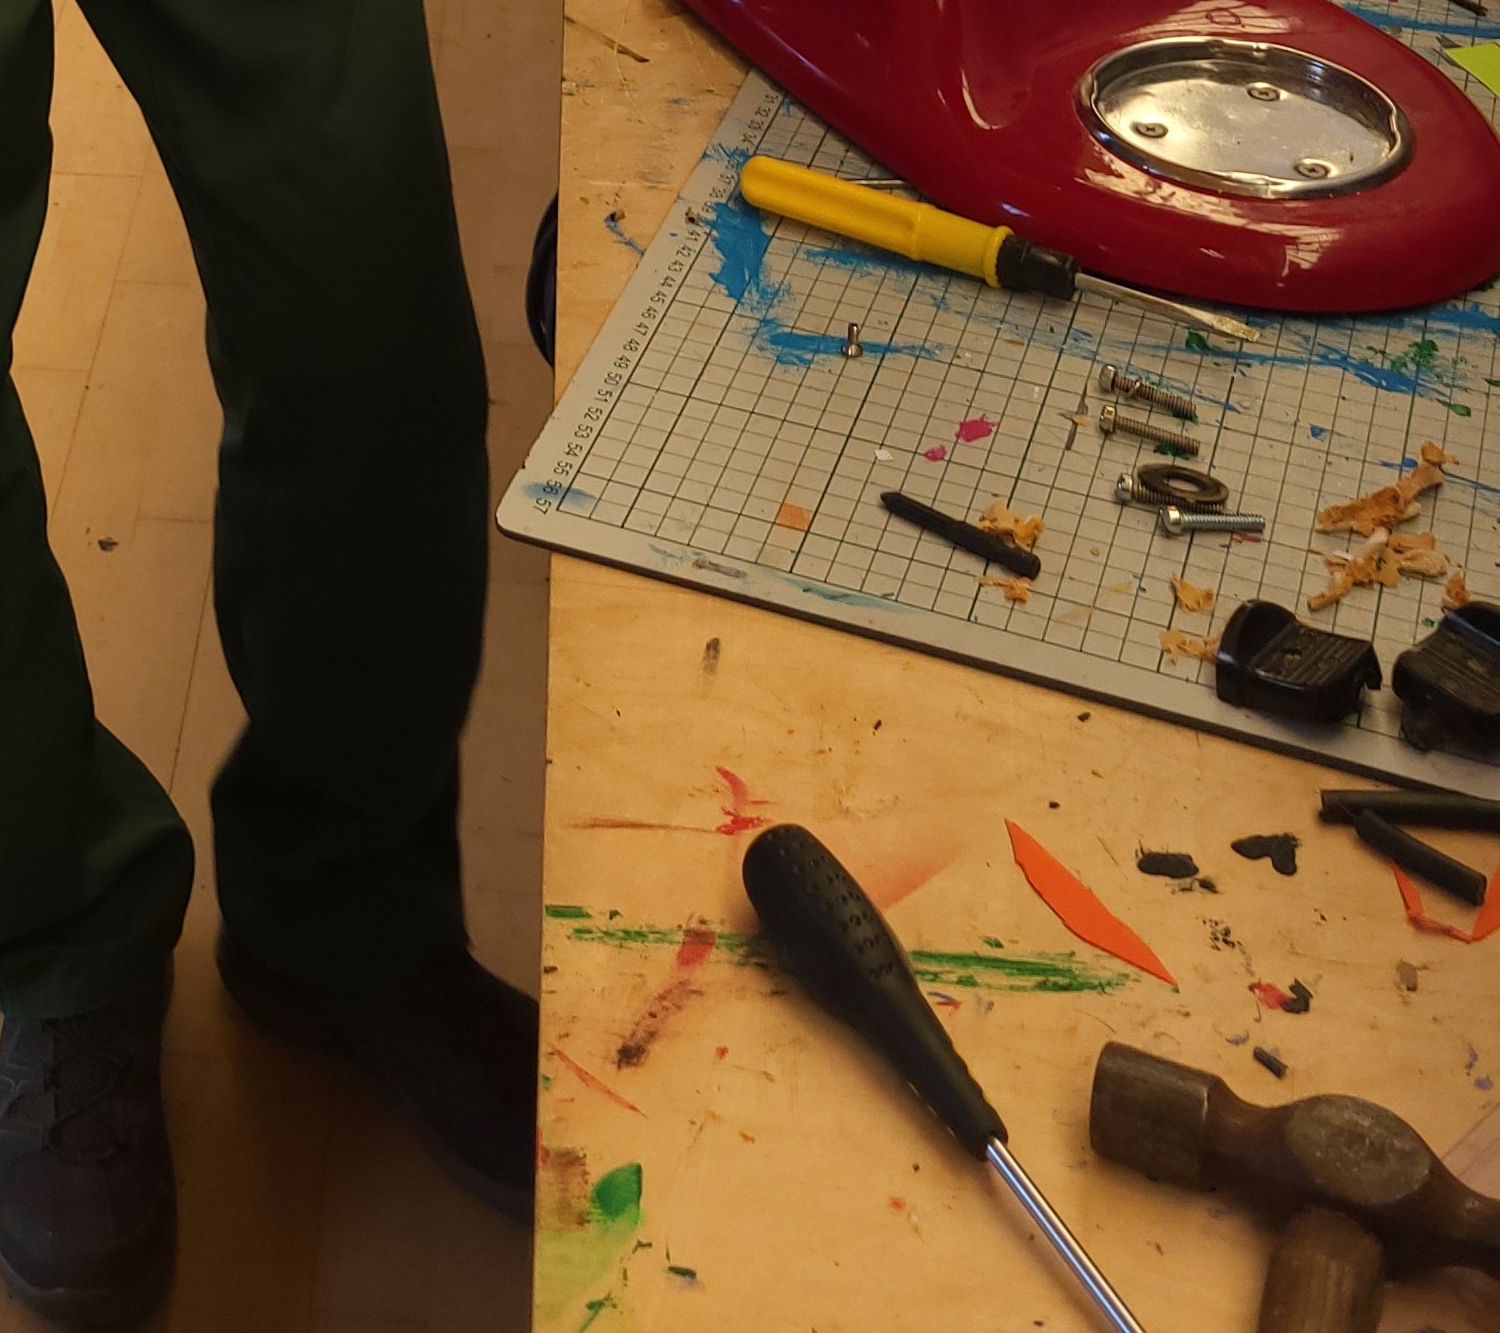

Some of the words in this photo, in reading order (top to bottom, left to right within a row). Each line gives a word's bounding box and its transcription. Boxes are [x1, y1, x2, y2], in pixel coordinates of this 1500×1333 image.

[685, 228, 702, 242] 41
[675, 244, 697, 259] 42
[667, 259, 685, 273] 43
[659, 275, 677, 289] 44
[649, 290, 668, 306] 45
[640, 305, 659, 321] 46
[633, 321, 650, 337] 47
[622, 338, 642, 353] 48
[613, 354, 632, 371] 49
[603, 371, 623, 387] 50
[593, 388, 614, 404] 51
[583, 405, 604, 422] 52
[573, 423, 594, 440] 53
[563, 441, 583, 458] 54
[553, 460, 574, 477] 55
[542, 478, 563, 496] 56
[532, 497, 552, 515] 57
